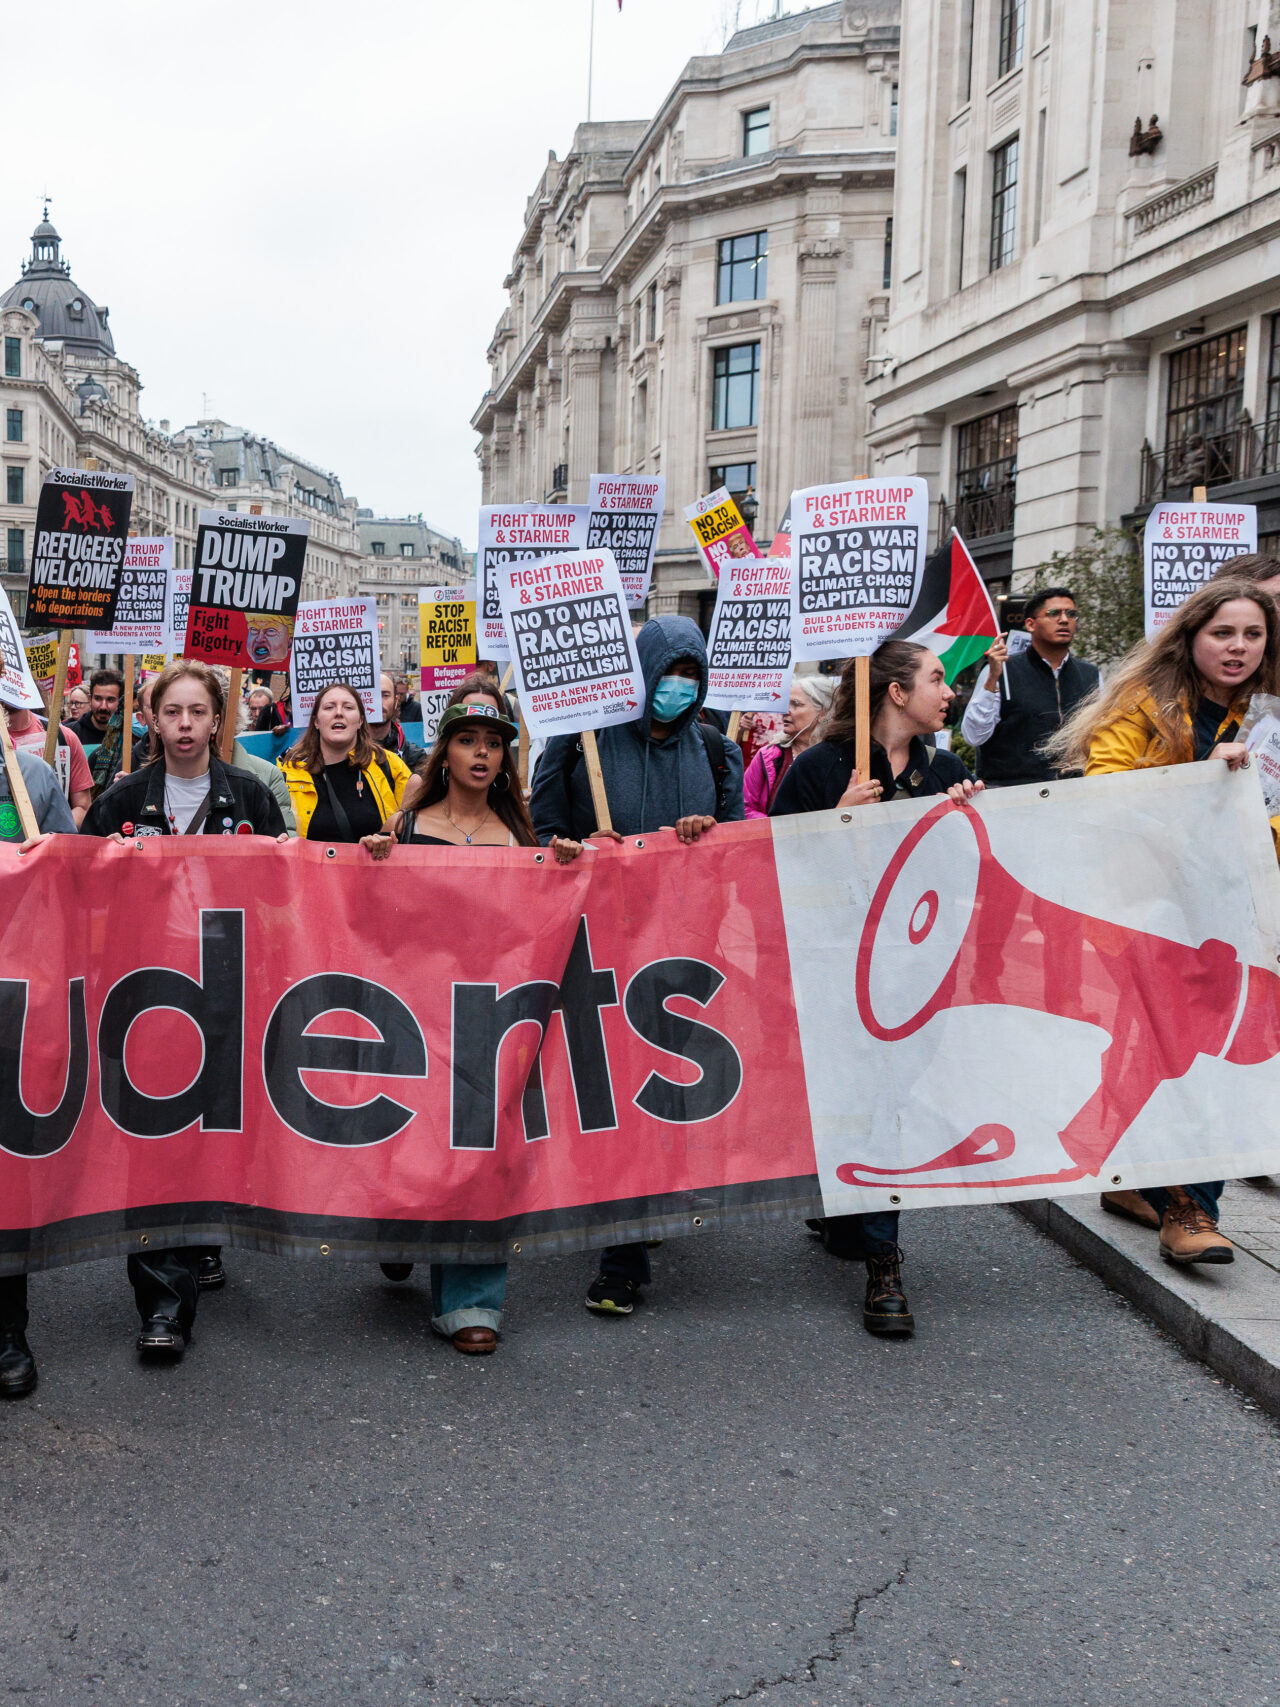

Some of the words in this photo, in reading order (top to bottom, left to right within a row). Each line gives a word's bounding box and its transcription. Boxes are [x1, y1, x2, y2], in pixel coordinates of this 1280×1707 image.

[598, 483, 627, 496] FIGHT
[628, 483, 658, 496] TRUMP
[806, 492, 852, 512] FIGHT
[856, 488, 913, 505] TRUMP
[600, 497, 608, 508] &
[610, 497, 652, 509] STARMER
[696, 515, 714, 531] NO
[715, 507, 728, 521] TO
[813, 513, 824, 528] &
[830, 506, 906, 526] STARMER
[1159, 512, 1197, 524] FIGHT
[1200, 513, 1245, 526] TRUMP
[701, 514, 740, 542] RACISM
[1163, 527, 1173, 538] &
[1177, 527, 1239, 539] STARMER
[37, 531, 123, 563] REFUGEES
[201, 530, 286, 572] DUMP
[708, 541, 727, 558] NO
[801, 536, 831, 554] NO
[837, 532, 862, 549] TO
[869, 529, 916, 547] WAR
[34, 558, 118, 589] WELCOME
[510, 566, 552, 588] FIGHT
[555, 558, 604, 581] TRUMP
[802, 549, 914, 578] RACISM
[38, 585, 58, 600] Open
[62, 587, 76, 600] the
[78, 588, 111, 603] borders
[198, 568, 296, 610] TRUMP
[520, 589, 532, 604] &
[535, 576, 604, 602] STARMER
[802, 575, 862, 592] CLIMATE
[866, 575, 912, 587] CHAOS
[36, 601, 46, 614] No
[49, 602, 103, 616] deportations
[803, 588, 910, 609] CAPITALISM
[194, 610, 230, 632] Fight
[296, 608, 327, 621] FIGHT
[329, 605, 367, 618] TRUMP
[435, 604, 464, 618] STOP
[513, 612, 542, 631] NO
[545, 606, 569, 626] TO
[574, 598, 619, 620] WAR
[302, 622, 309, 633] &
[313, 618, 362, 632] STARMER
[429, 619, 469, 633] RACIST
[192, 631, 242, 656] Bigotry
[426, 633, 471, 649] REFORM
[518, 617, 623, 657] RACISM
[30, 644, 51, 655] STOP
[443, 649, 457, 662] UK
[523, 650, 579, 671] CLIMATE
[581, 642, 625, 659] CHAOS
[36, 669, 48, 678] UK
[434, 667, 466, 678] Refugees
[526, 655, 628, 688] CAPITALISM
